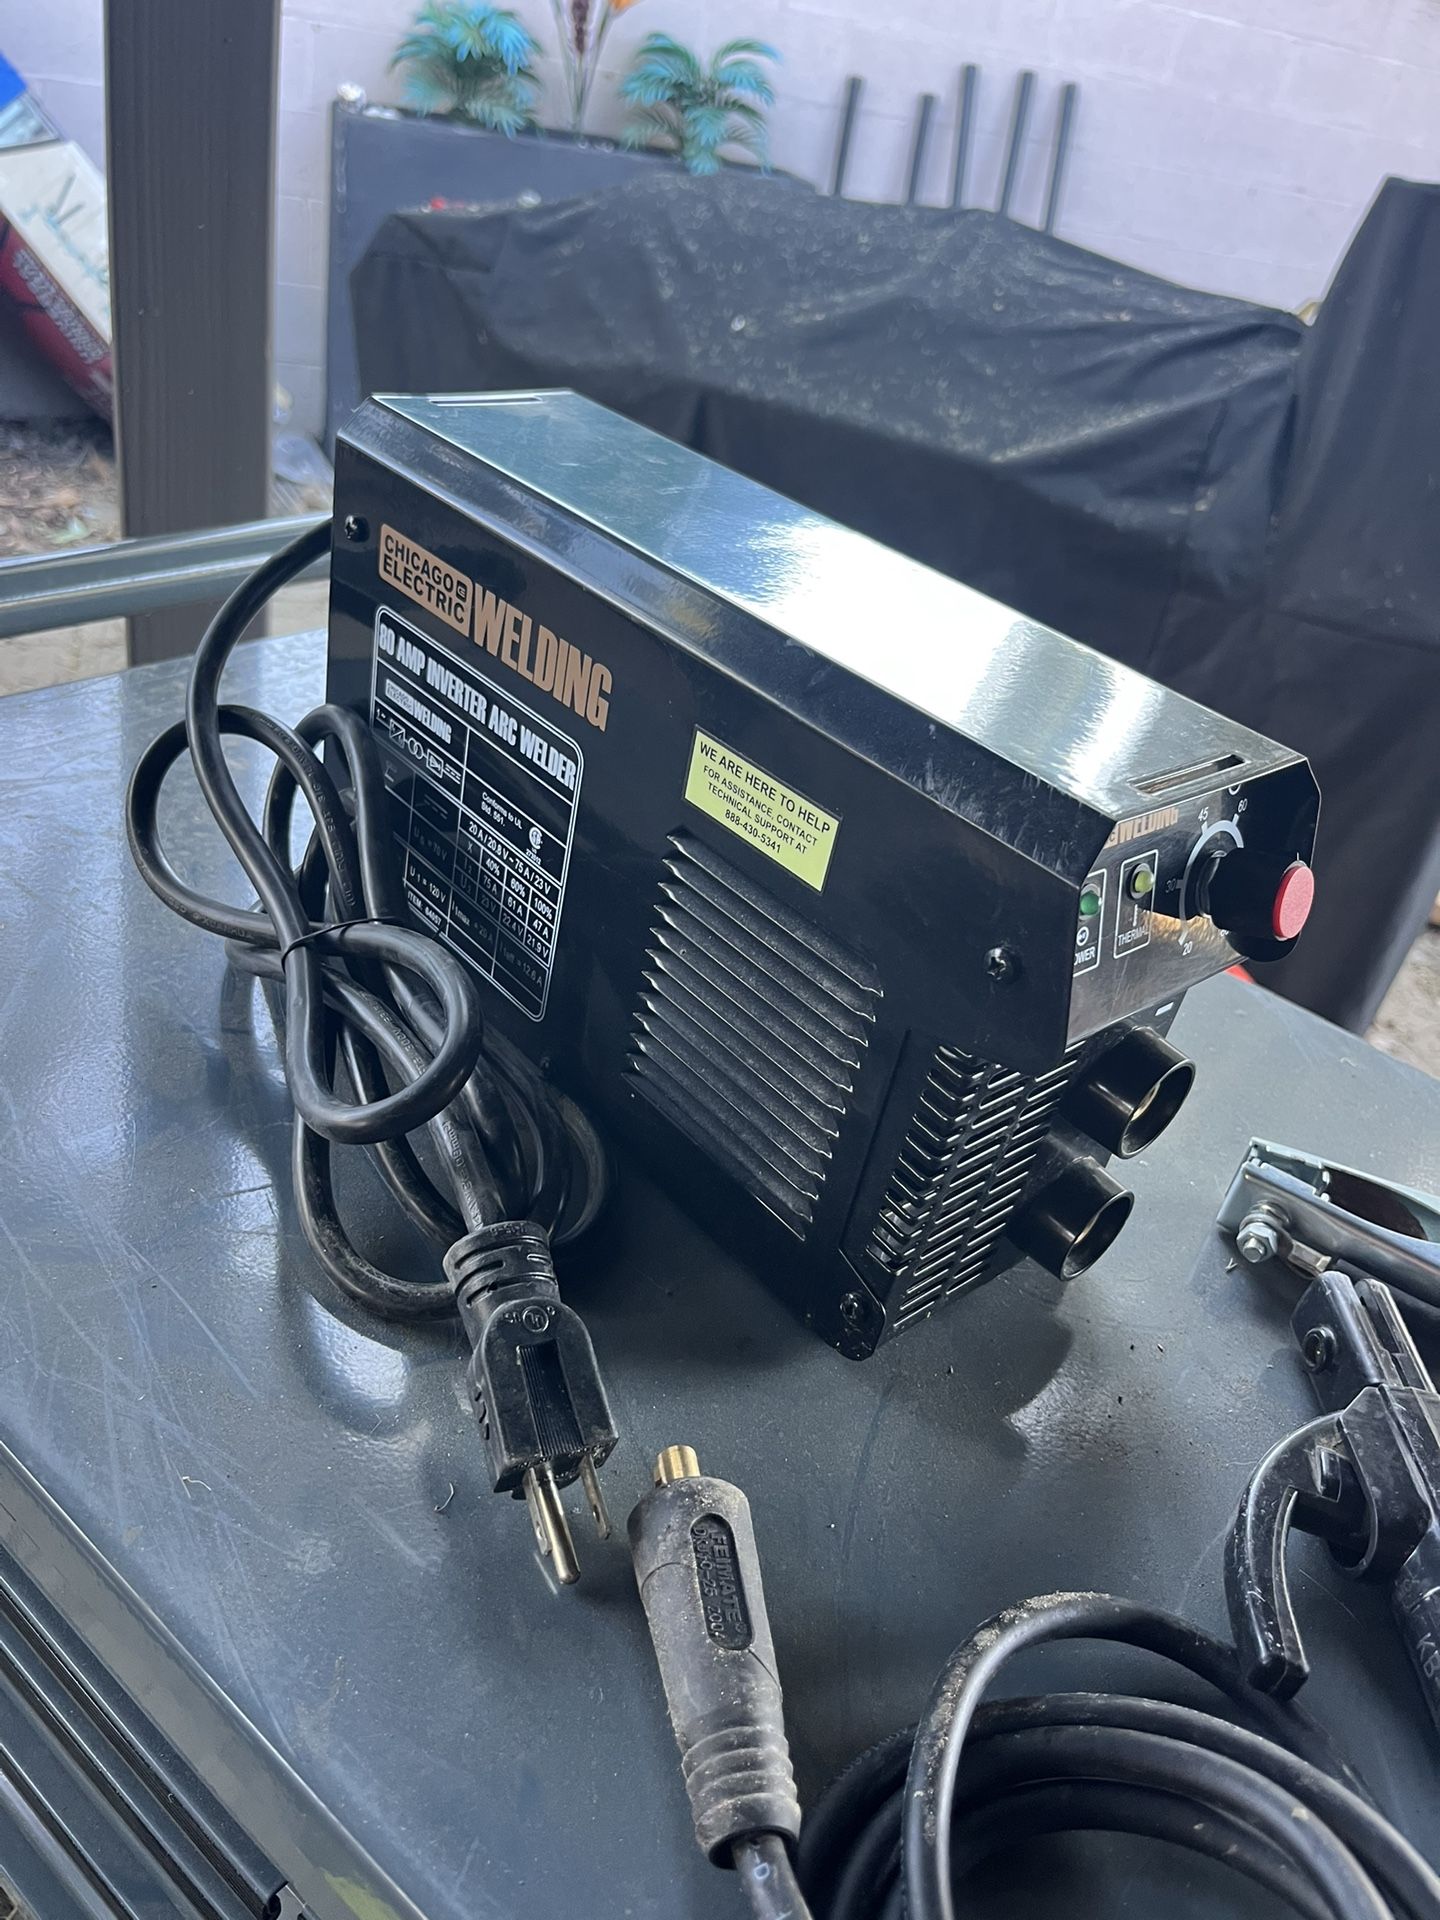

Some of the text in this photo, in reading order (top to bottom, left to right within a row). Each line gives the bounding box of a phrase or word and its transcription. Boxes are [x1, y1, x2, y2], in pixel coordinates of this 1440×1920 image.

[383, 553, 465, 624] ELECTRIC
[384, 534, 454, 593] CHICAGO
[473, 583, 613, 732] WELDING
[378, 622, 396, 656] 80
[397, 636, 426, 676] AMP
[426, 657, 488, 724] INVERTER
[488, 704, 518, 746] ARC
[520, 725, 577, 791] WELDER
[412, 699, 452, 745] WELDING
[482, 791, 507, 817] Conforms
[700, 741, 831, 834] WE ARE HERE TO HELP
[703, 765, 818, 846] FOR ASSISTANCE, CONTACT
[1197, 806, 1209, 821] 45
[1237, 798, 1248, 813] 60
[708, 782, 807, 854] TECHNICAL SUPPORT AT
[725, 809, 781, 853] 888-430-5341
[469, 821, 478, 835] 20
[478, 829, 484, 841] A
[514, 858, 523, 874] 75
[523, 867, 530, 879] A
[533, 875, 544, 889] 23
[544, 882, 551, 894] V
[485, 858, 500, 876] 40%
[510, 878, 525, 897] 60%
[534, 897, 552, 920] 100%
[532, 918, 543, 932] 47
[543, 926, 549, 939] A
[1118, 924, 1149, 946] THERMAL
[1182, 941, 1193, 956] 20
